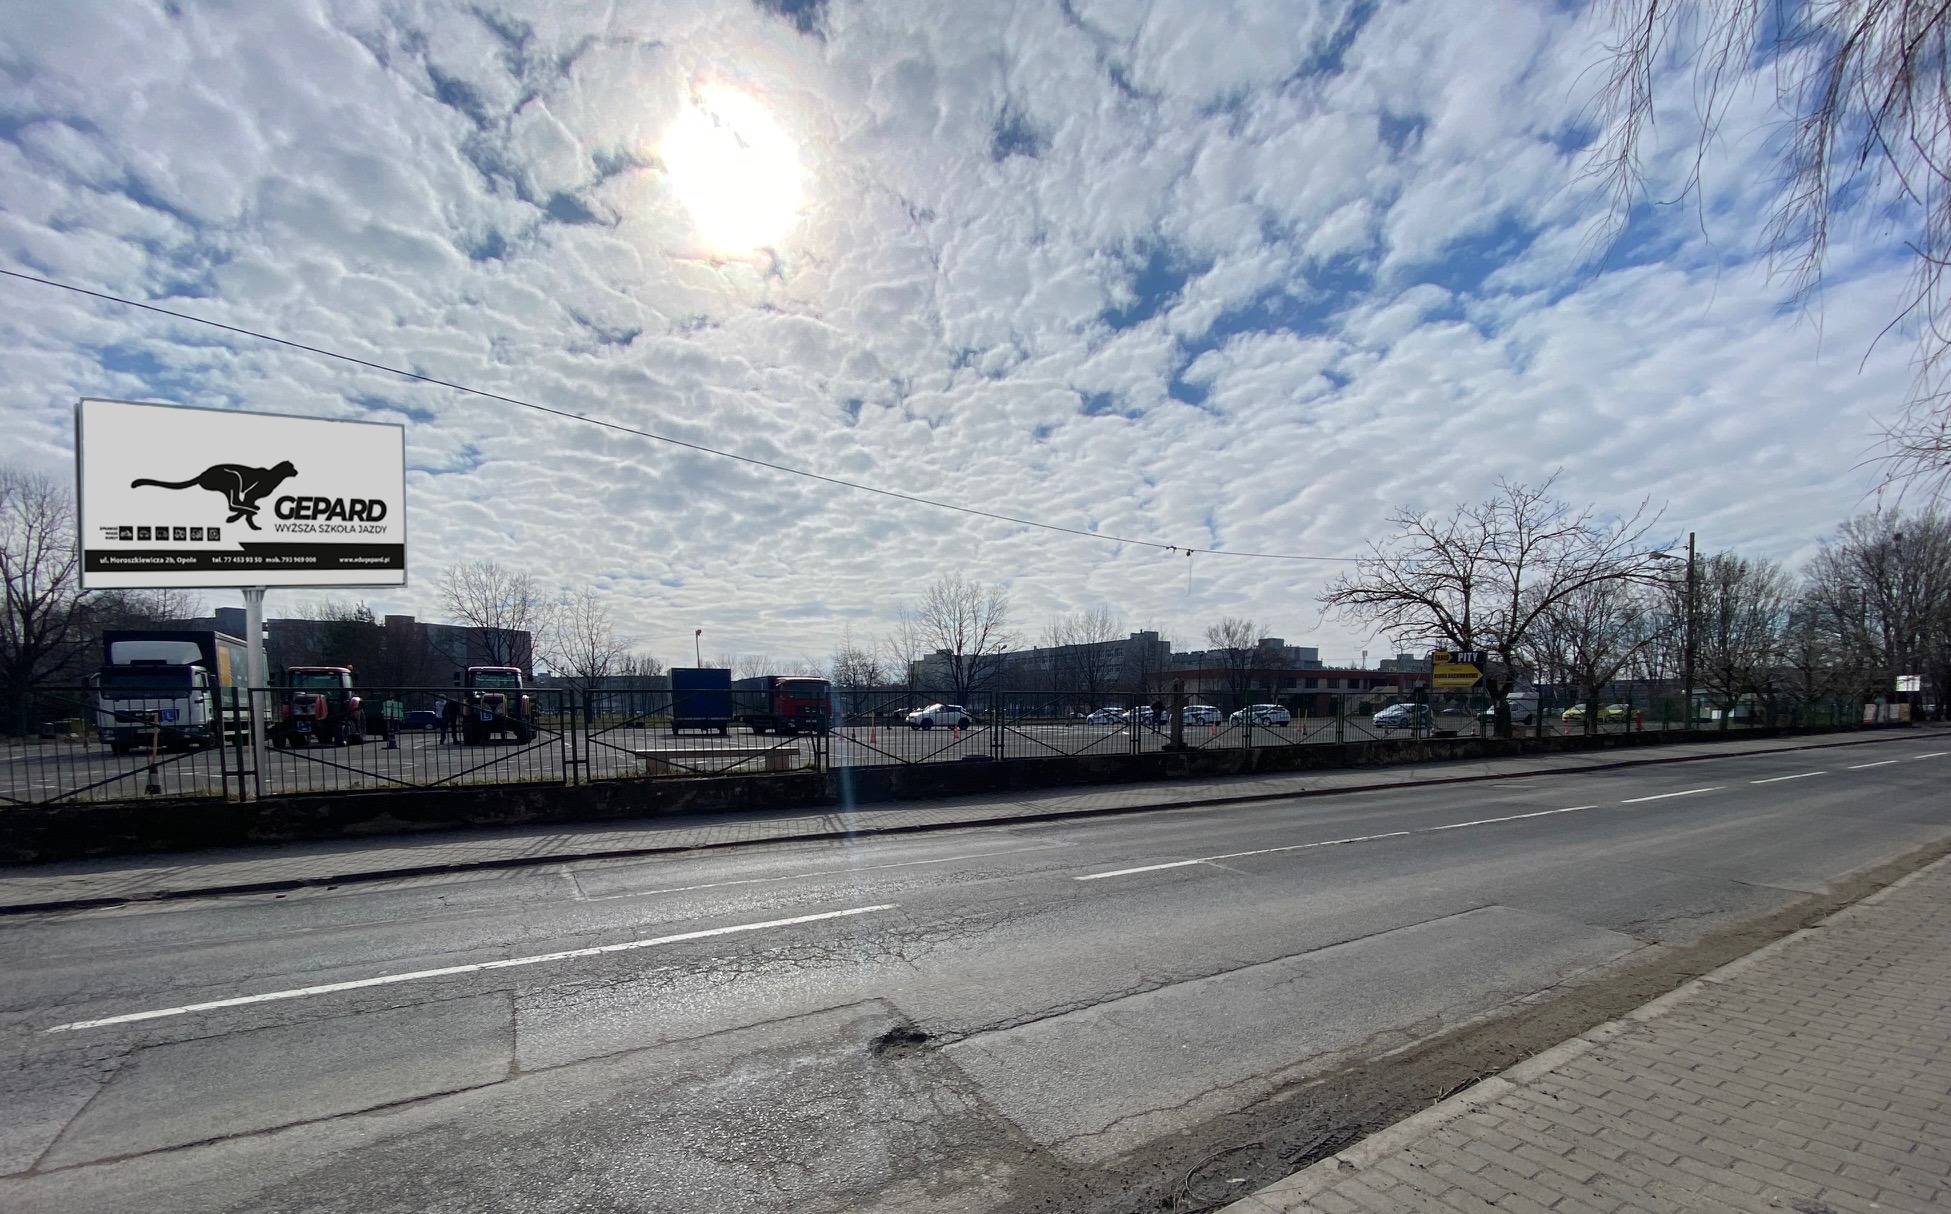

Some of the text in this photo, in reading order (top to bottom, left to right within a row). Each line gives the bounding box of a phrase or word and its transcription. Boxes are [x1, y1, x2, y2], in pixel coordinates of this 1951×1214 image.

[274, 495, 387, 522] GEPARD
[274, 522, 387, 534] WYŻSZA SZKOŁA JAZDY
[176, 557, 197, 565] Opole
[1457, 652, 1478, 662] PITY
